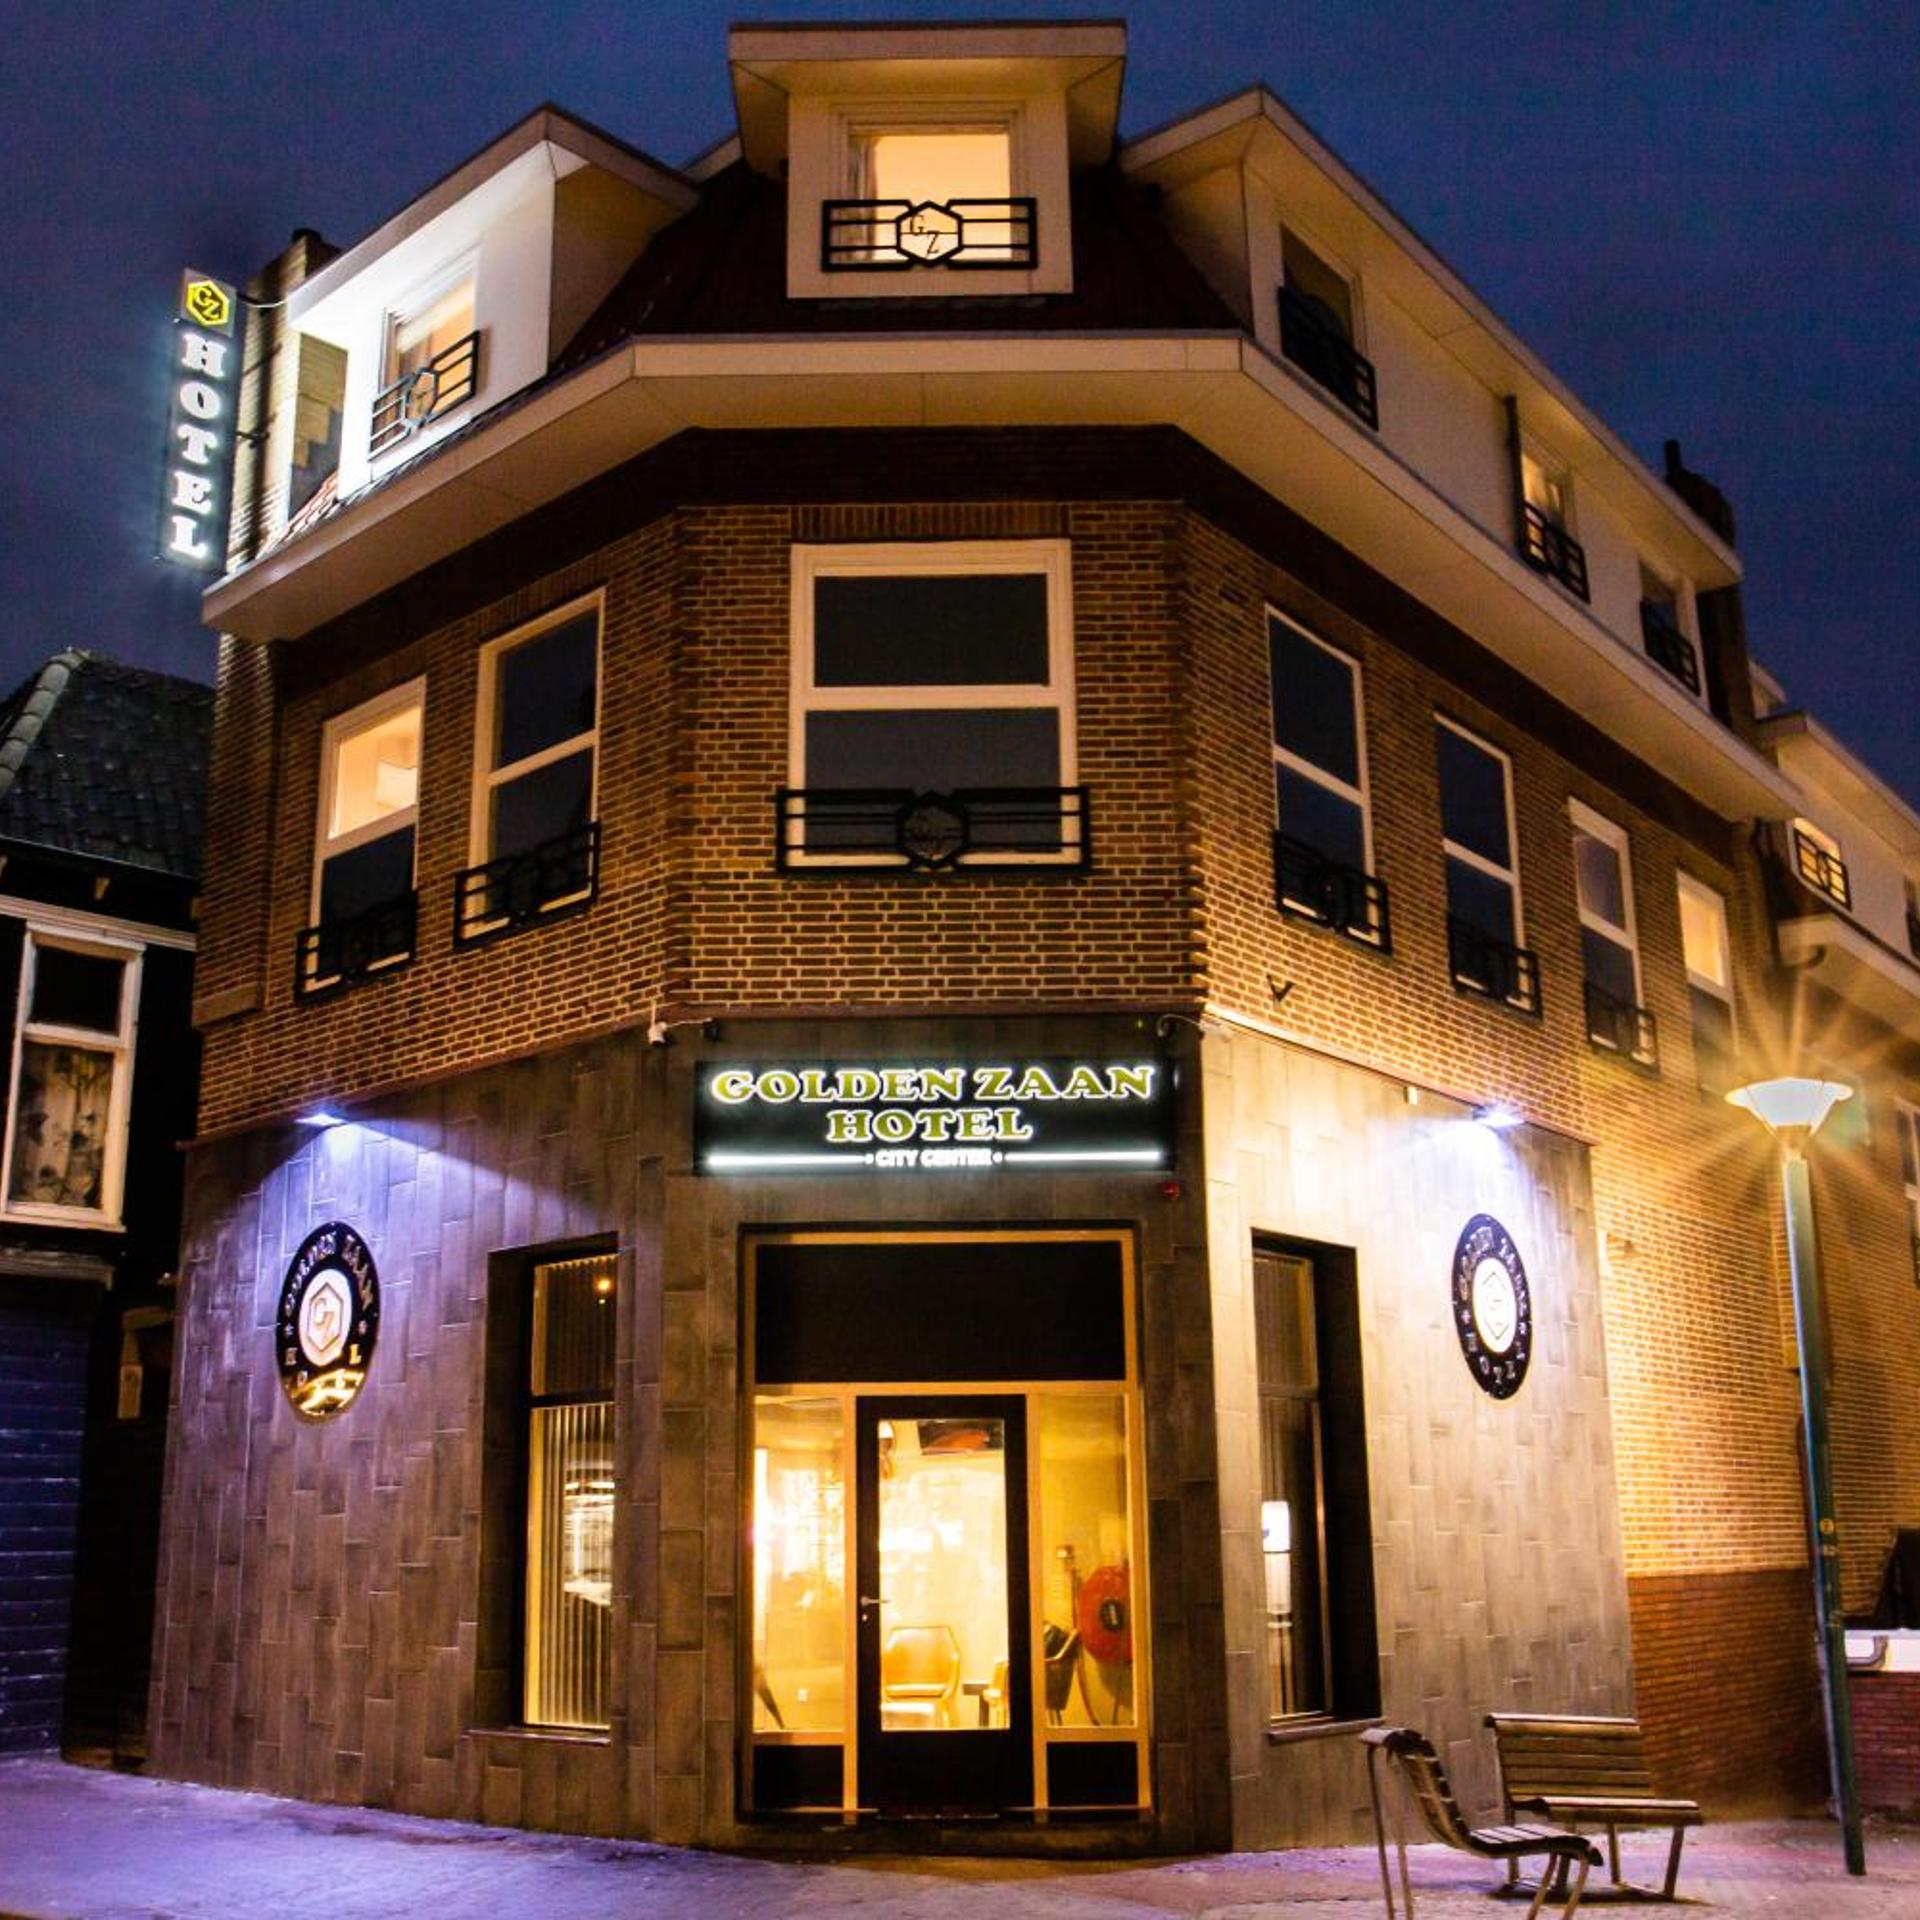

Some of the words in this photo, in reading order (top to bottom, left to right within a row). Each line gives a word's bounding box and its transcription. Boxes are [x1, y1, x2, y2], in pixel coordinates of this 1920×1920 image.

[169, 332, 227, 560] HOTEL
[711, 1066, 966, 1103] GOLDEN
[973, 1065, 1155, 1100] ZAAN
[825, 1107, 1033, 1142] HOTEL
[876, 1148, 919, 1167] CITY
